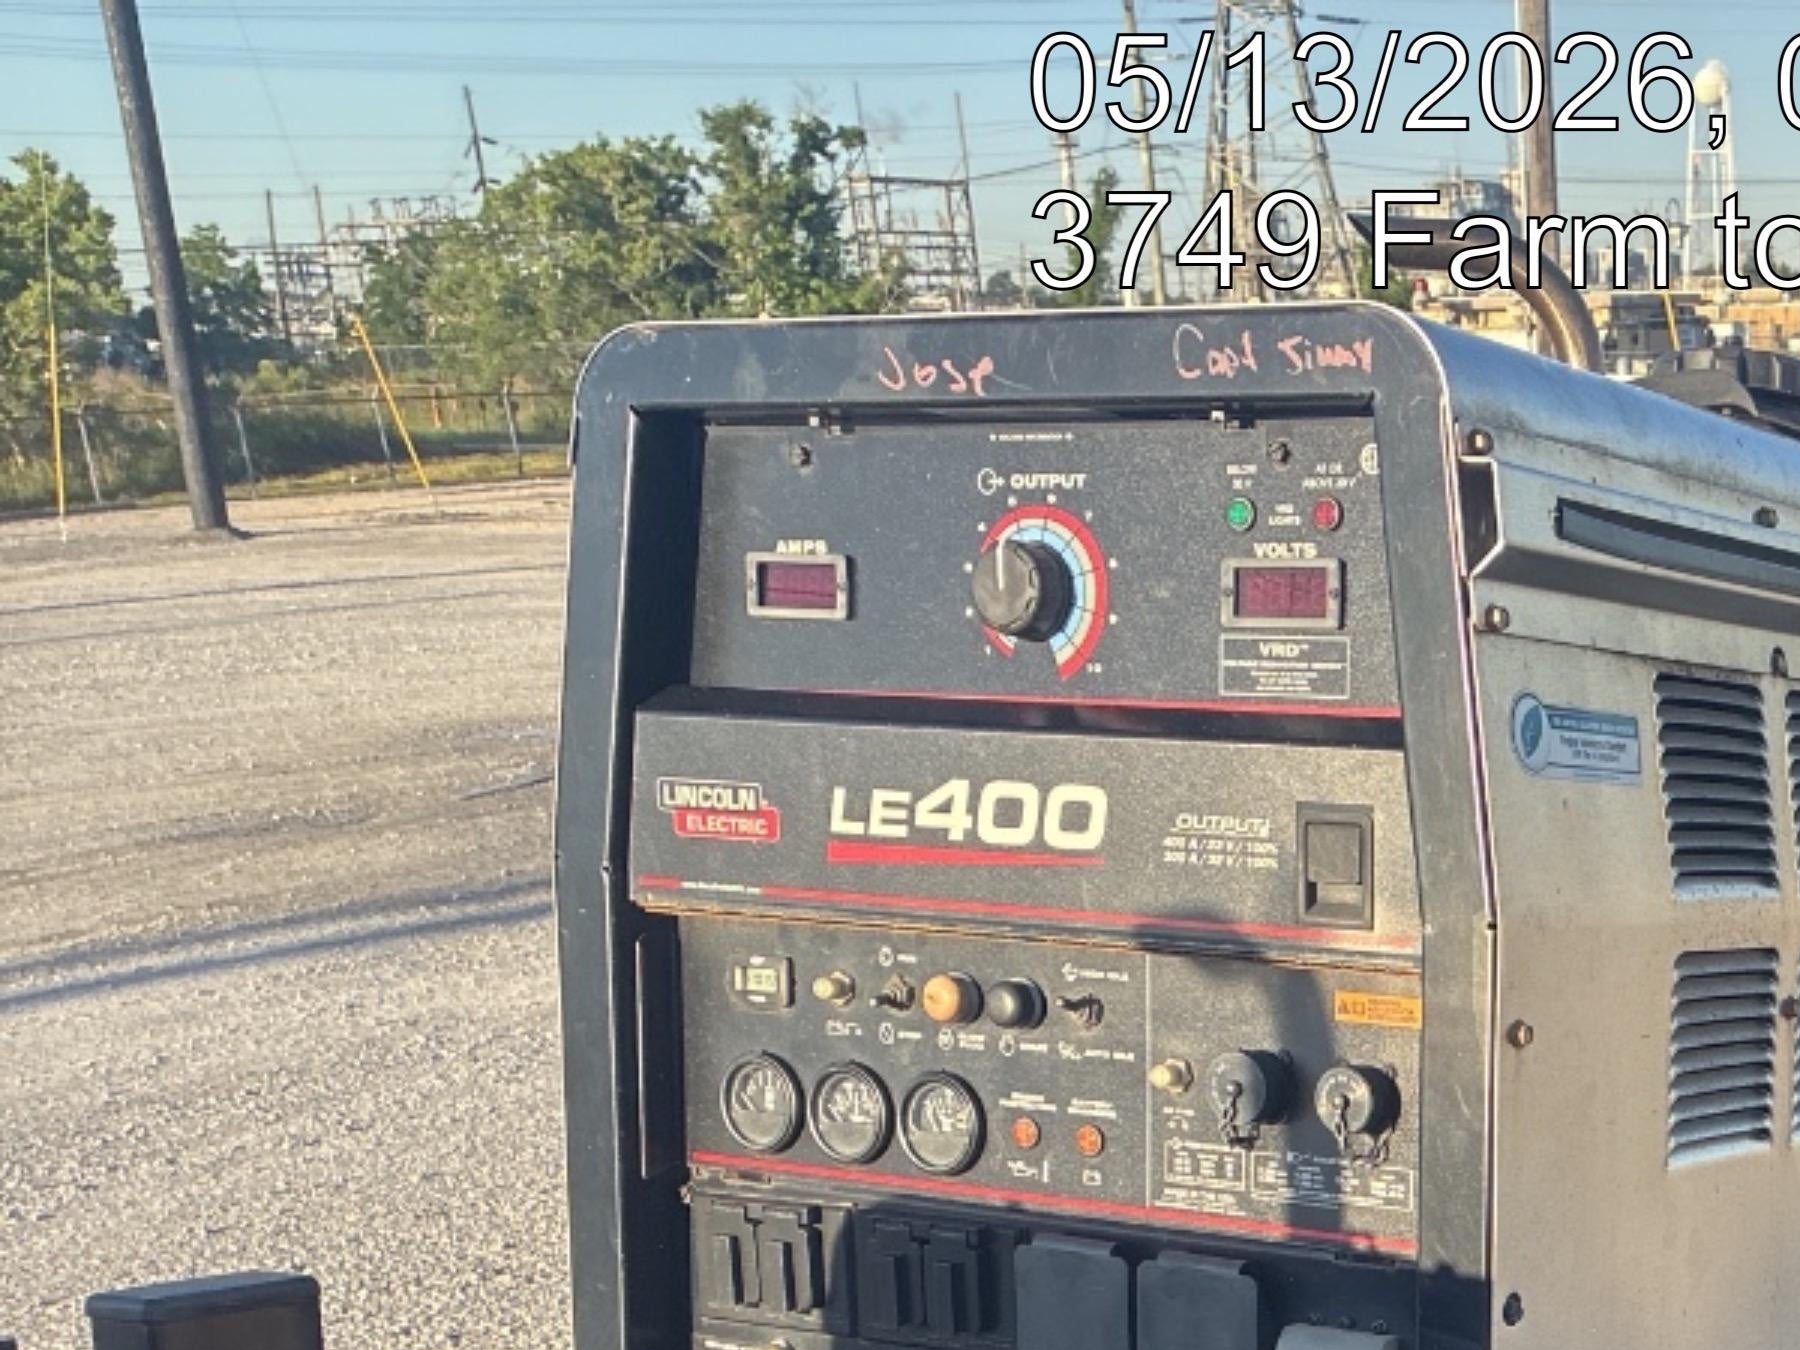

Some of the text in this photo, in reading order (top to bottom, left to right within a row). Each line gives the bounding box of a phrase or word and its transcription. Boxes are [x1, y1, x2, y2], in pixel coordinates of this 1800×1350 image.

[1010, 472, 1087, 490] OUTPUT
[776, 539, 828, 556] AMPS
[1253, 541, 1318, 560] VOLTS
[662, 783, 758, 812] LINCOLN
[828, 778, 1109, 852] LE400
[1175, 812, 1265, 833] OUTPUT
[686, 815, 769, 837] ELECTRIC
